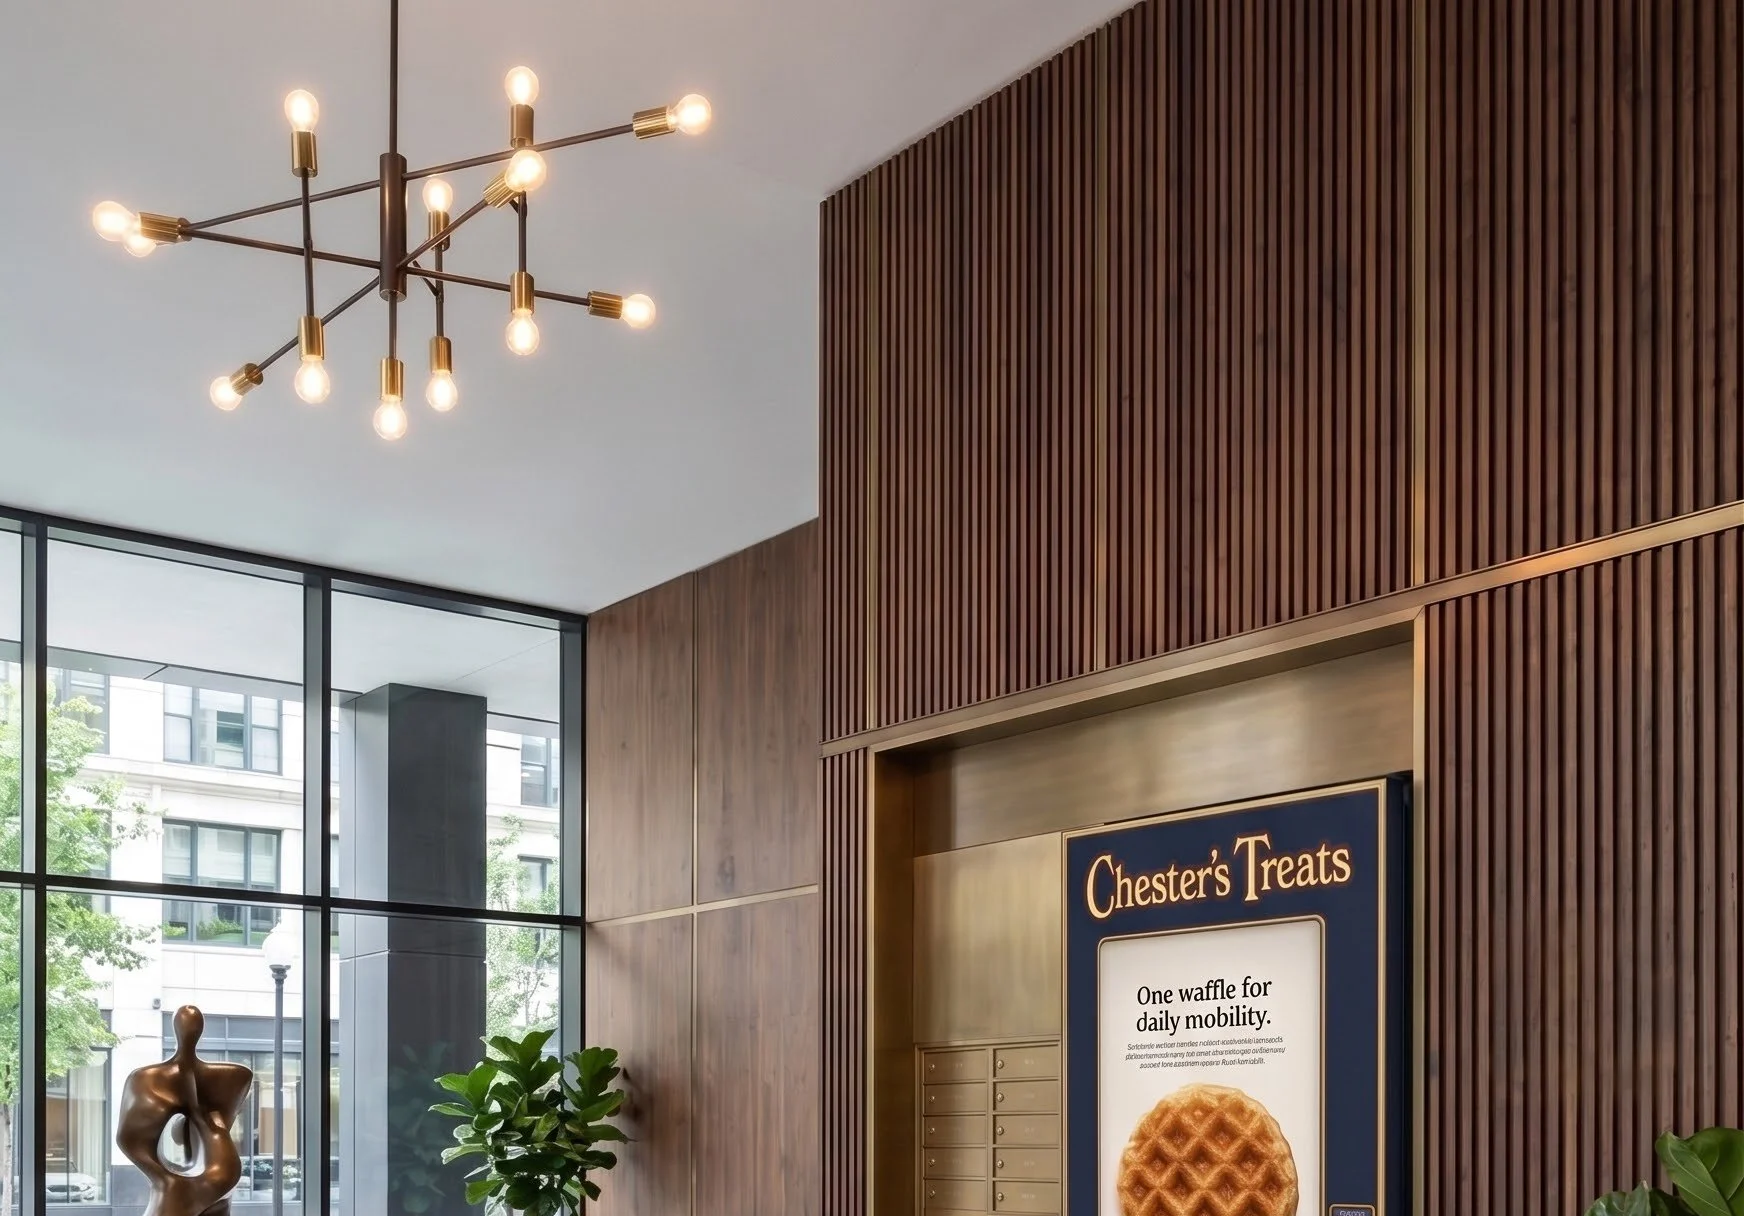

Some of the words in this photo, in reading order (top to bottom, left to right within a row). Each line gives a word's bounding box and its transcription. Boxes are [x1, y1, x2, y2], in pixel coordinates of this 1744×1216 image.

[1086, 848, 1231, 920] Chester's
[1233, 833, 1352, 902] Treats
[1137, 985, 1174, 1006] One
[1178, 978, 1236, 1003] waffle
[1242, 976, 1272, 998] for
[1136, 1011, 1180, 1036] daily
[1185, 1004, 1272, 1031] mobility.
